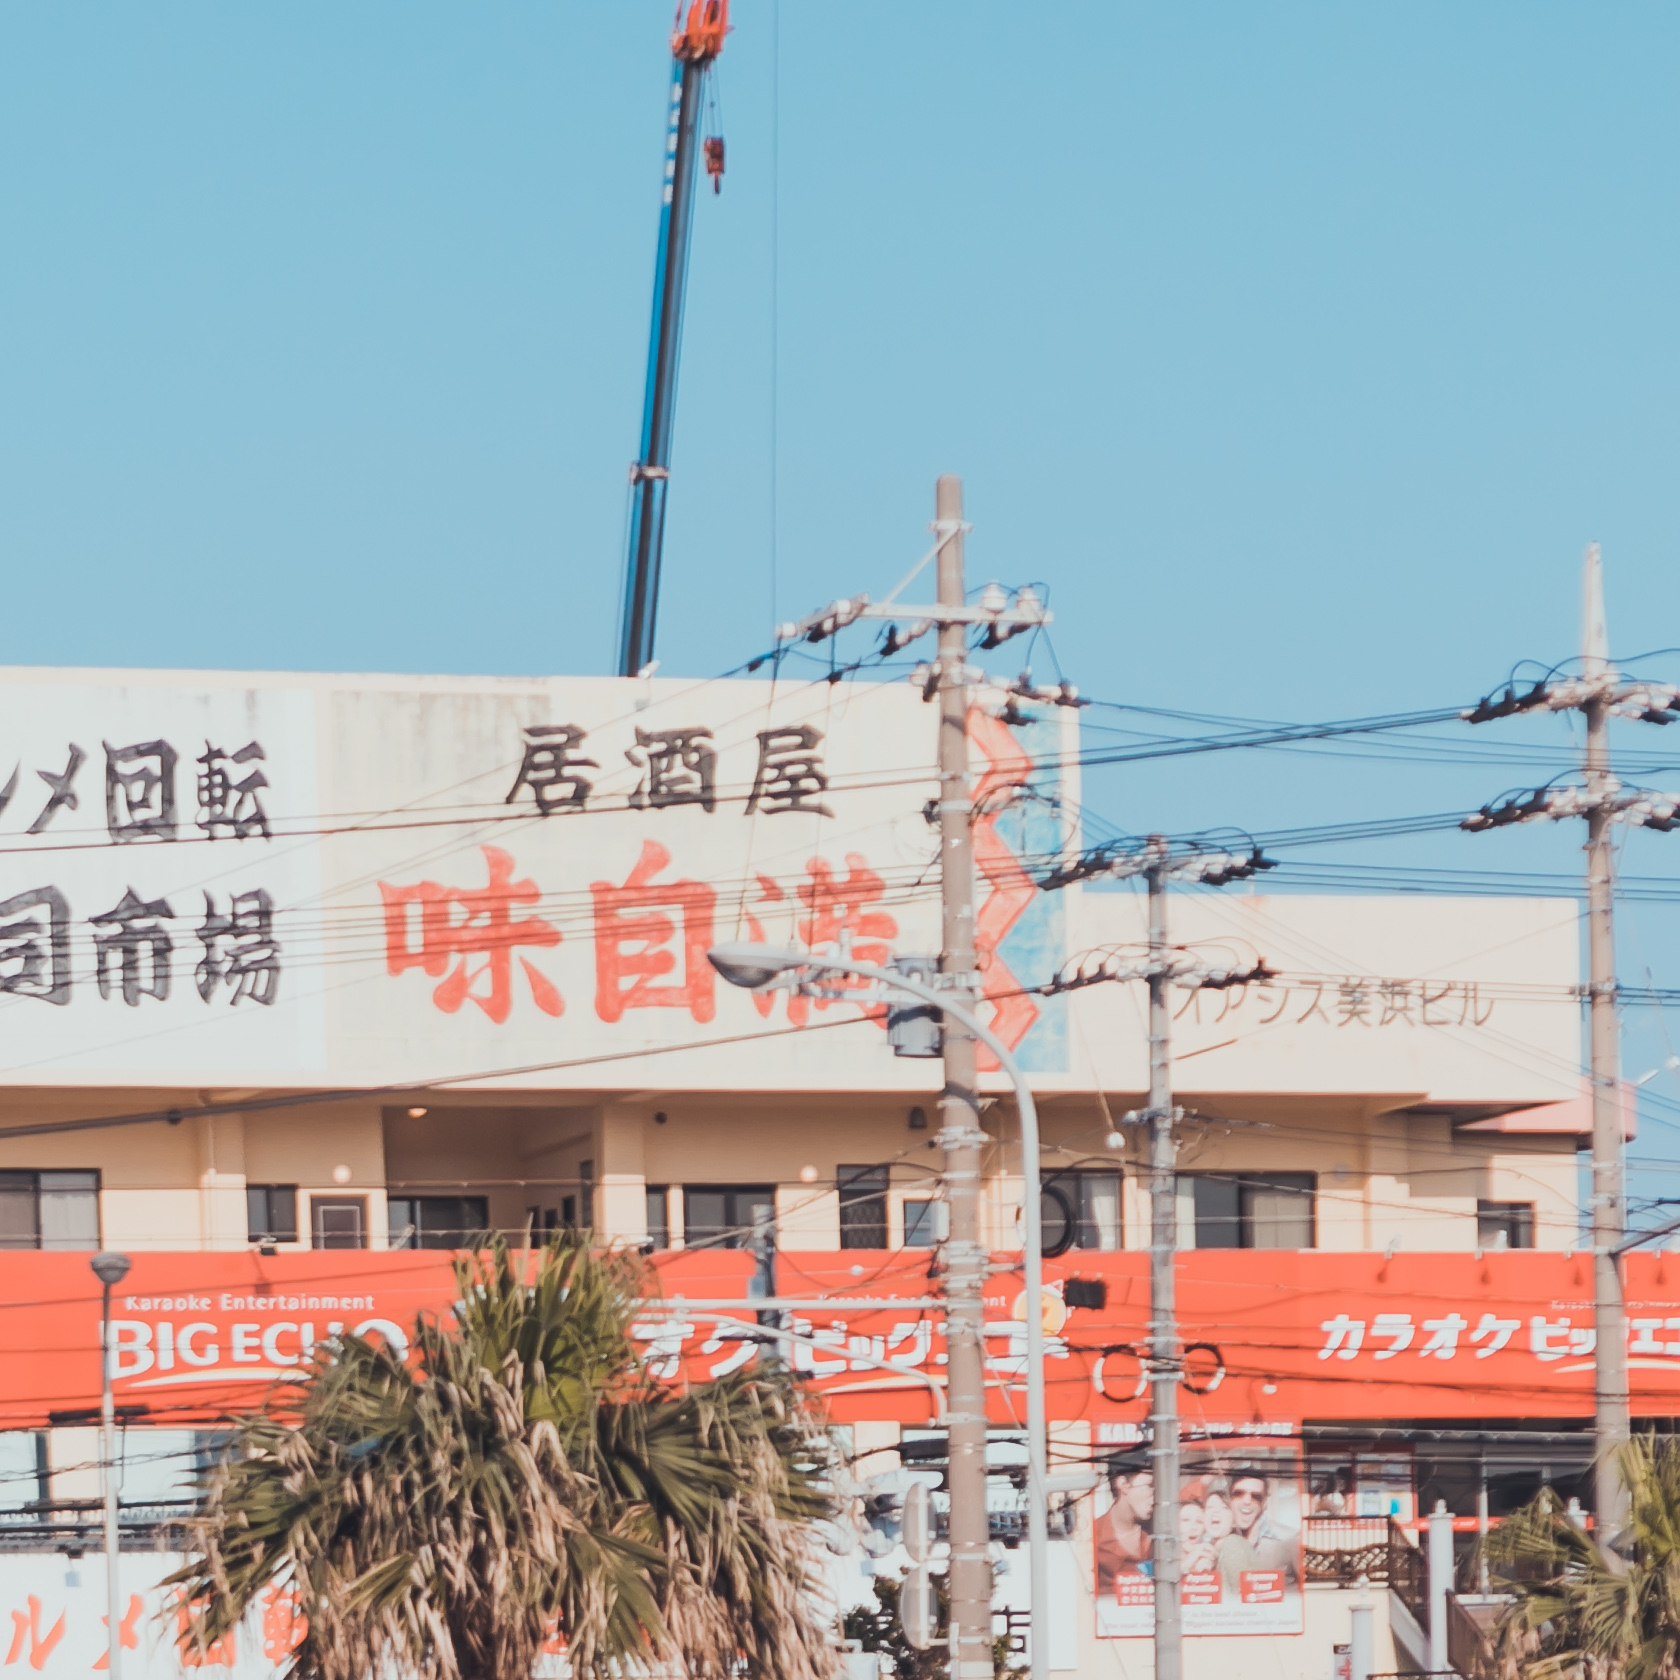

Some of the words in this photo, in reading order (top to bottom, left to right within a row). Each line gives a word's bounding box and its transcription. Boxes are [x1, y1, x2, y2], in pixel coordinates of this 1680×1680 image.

[506, 723, 835, 820] 居酒屋
[377, 839, 901, 1030] 味自満
[1172, 976, 1495, 1027] オアシス美浜ビル
[125, 1293, 212, 1312] Karaoke
[220, 1293, 375, 1312] Entertainment
[102, 1320, 221, 1380] BIG
